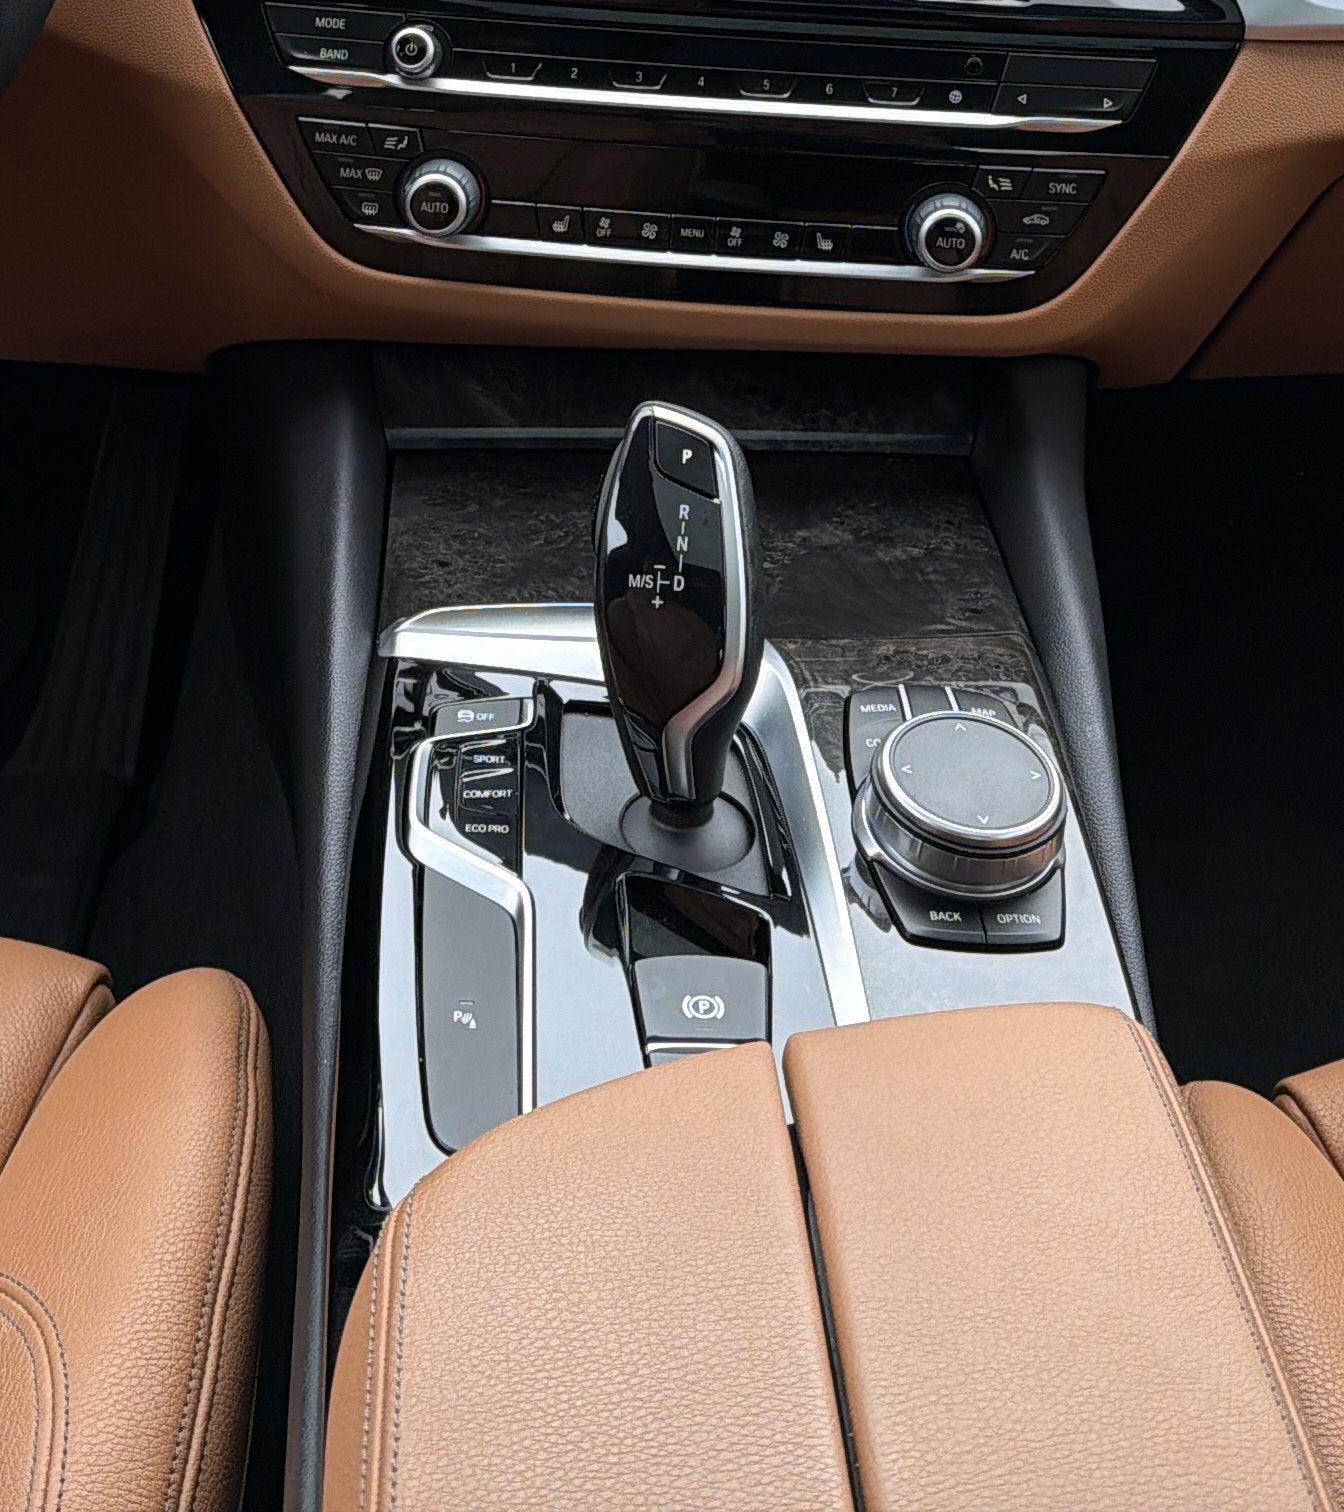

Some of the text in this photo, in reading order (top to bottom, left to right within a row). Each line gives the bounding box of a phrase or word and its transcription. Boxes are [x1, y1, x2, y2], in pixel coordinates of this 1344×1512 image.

[315, 16, 346, 31] MODE
[319, 47, 349, 61] BAND
[571, 68, 578, 79] 2
[635, 71, 643, 82] 3
[697, 76, 705, 87] 4
[763, 79, 771, 90] 5
[826, 83, 834, 95] 6
[891, 87, 898, 99] 7
[315, 132, 358, 146] MAX A/C
[340, 168, 363, 179] MAX
[1048, 182, 1078, 195] SYNC
[420, 201, 449, 214] AUTO
[596, 228, 612, 237] OFF
[680, 228, 705, 238] MENU
[727, 238, 743, 247] OFF
[936, 237, 966, 249] AUTO
[1010, 248, 1029, 261] A/C
[682, 449, 692, 464] P
[679, 504, 690, 520] R
[676, 535, 688, 552] N
[628, 573, 654, 589] M/S
[673, 575, 685, 592] D
[860, 704, 897, 713] MEDIA
[476, 712, 495, 721] OFF
[473, 754, 505, 764] SPORT
[463, 789, 512, 799] COMFORT
[465, 823, 509, 834] ECO PRO
[929, 910, 962, 922] BACK
[996, 913, 1041, 925] OPTION
